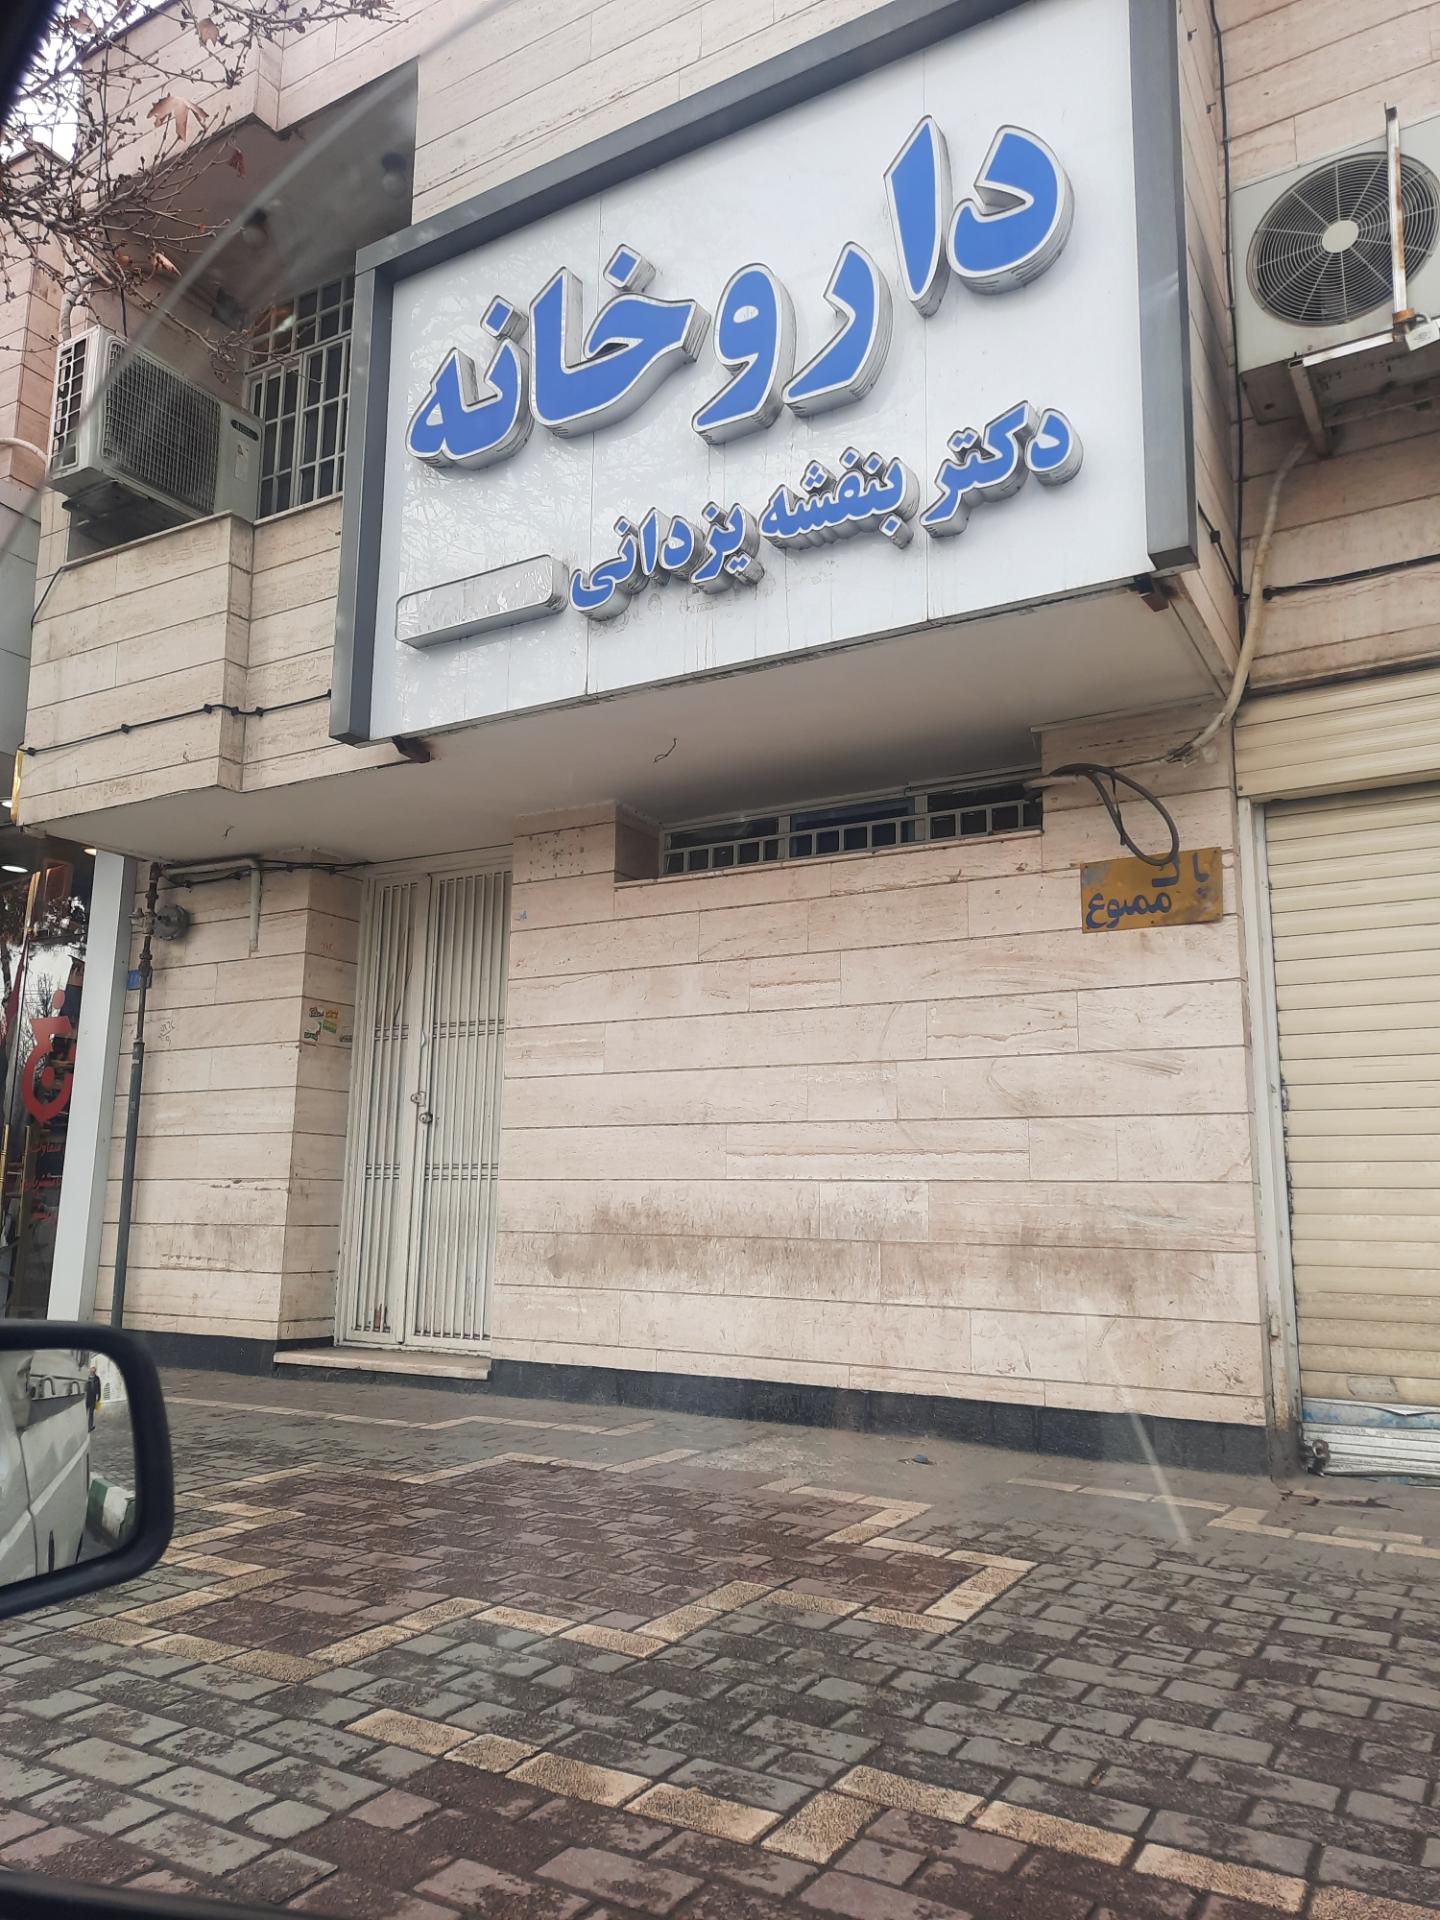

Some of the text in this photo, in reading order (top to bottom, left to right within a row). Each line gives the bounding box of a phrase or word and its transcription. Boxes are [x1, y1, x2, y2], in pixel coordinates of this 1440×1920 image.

[406, 114, 1074, 472] داروخانه
[568, 400, 1080, 615] دکتر بنفشه یزدانی
